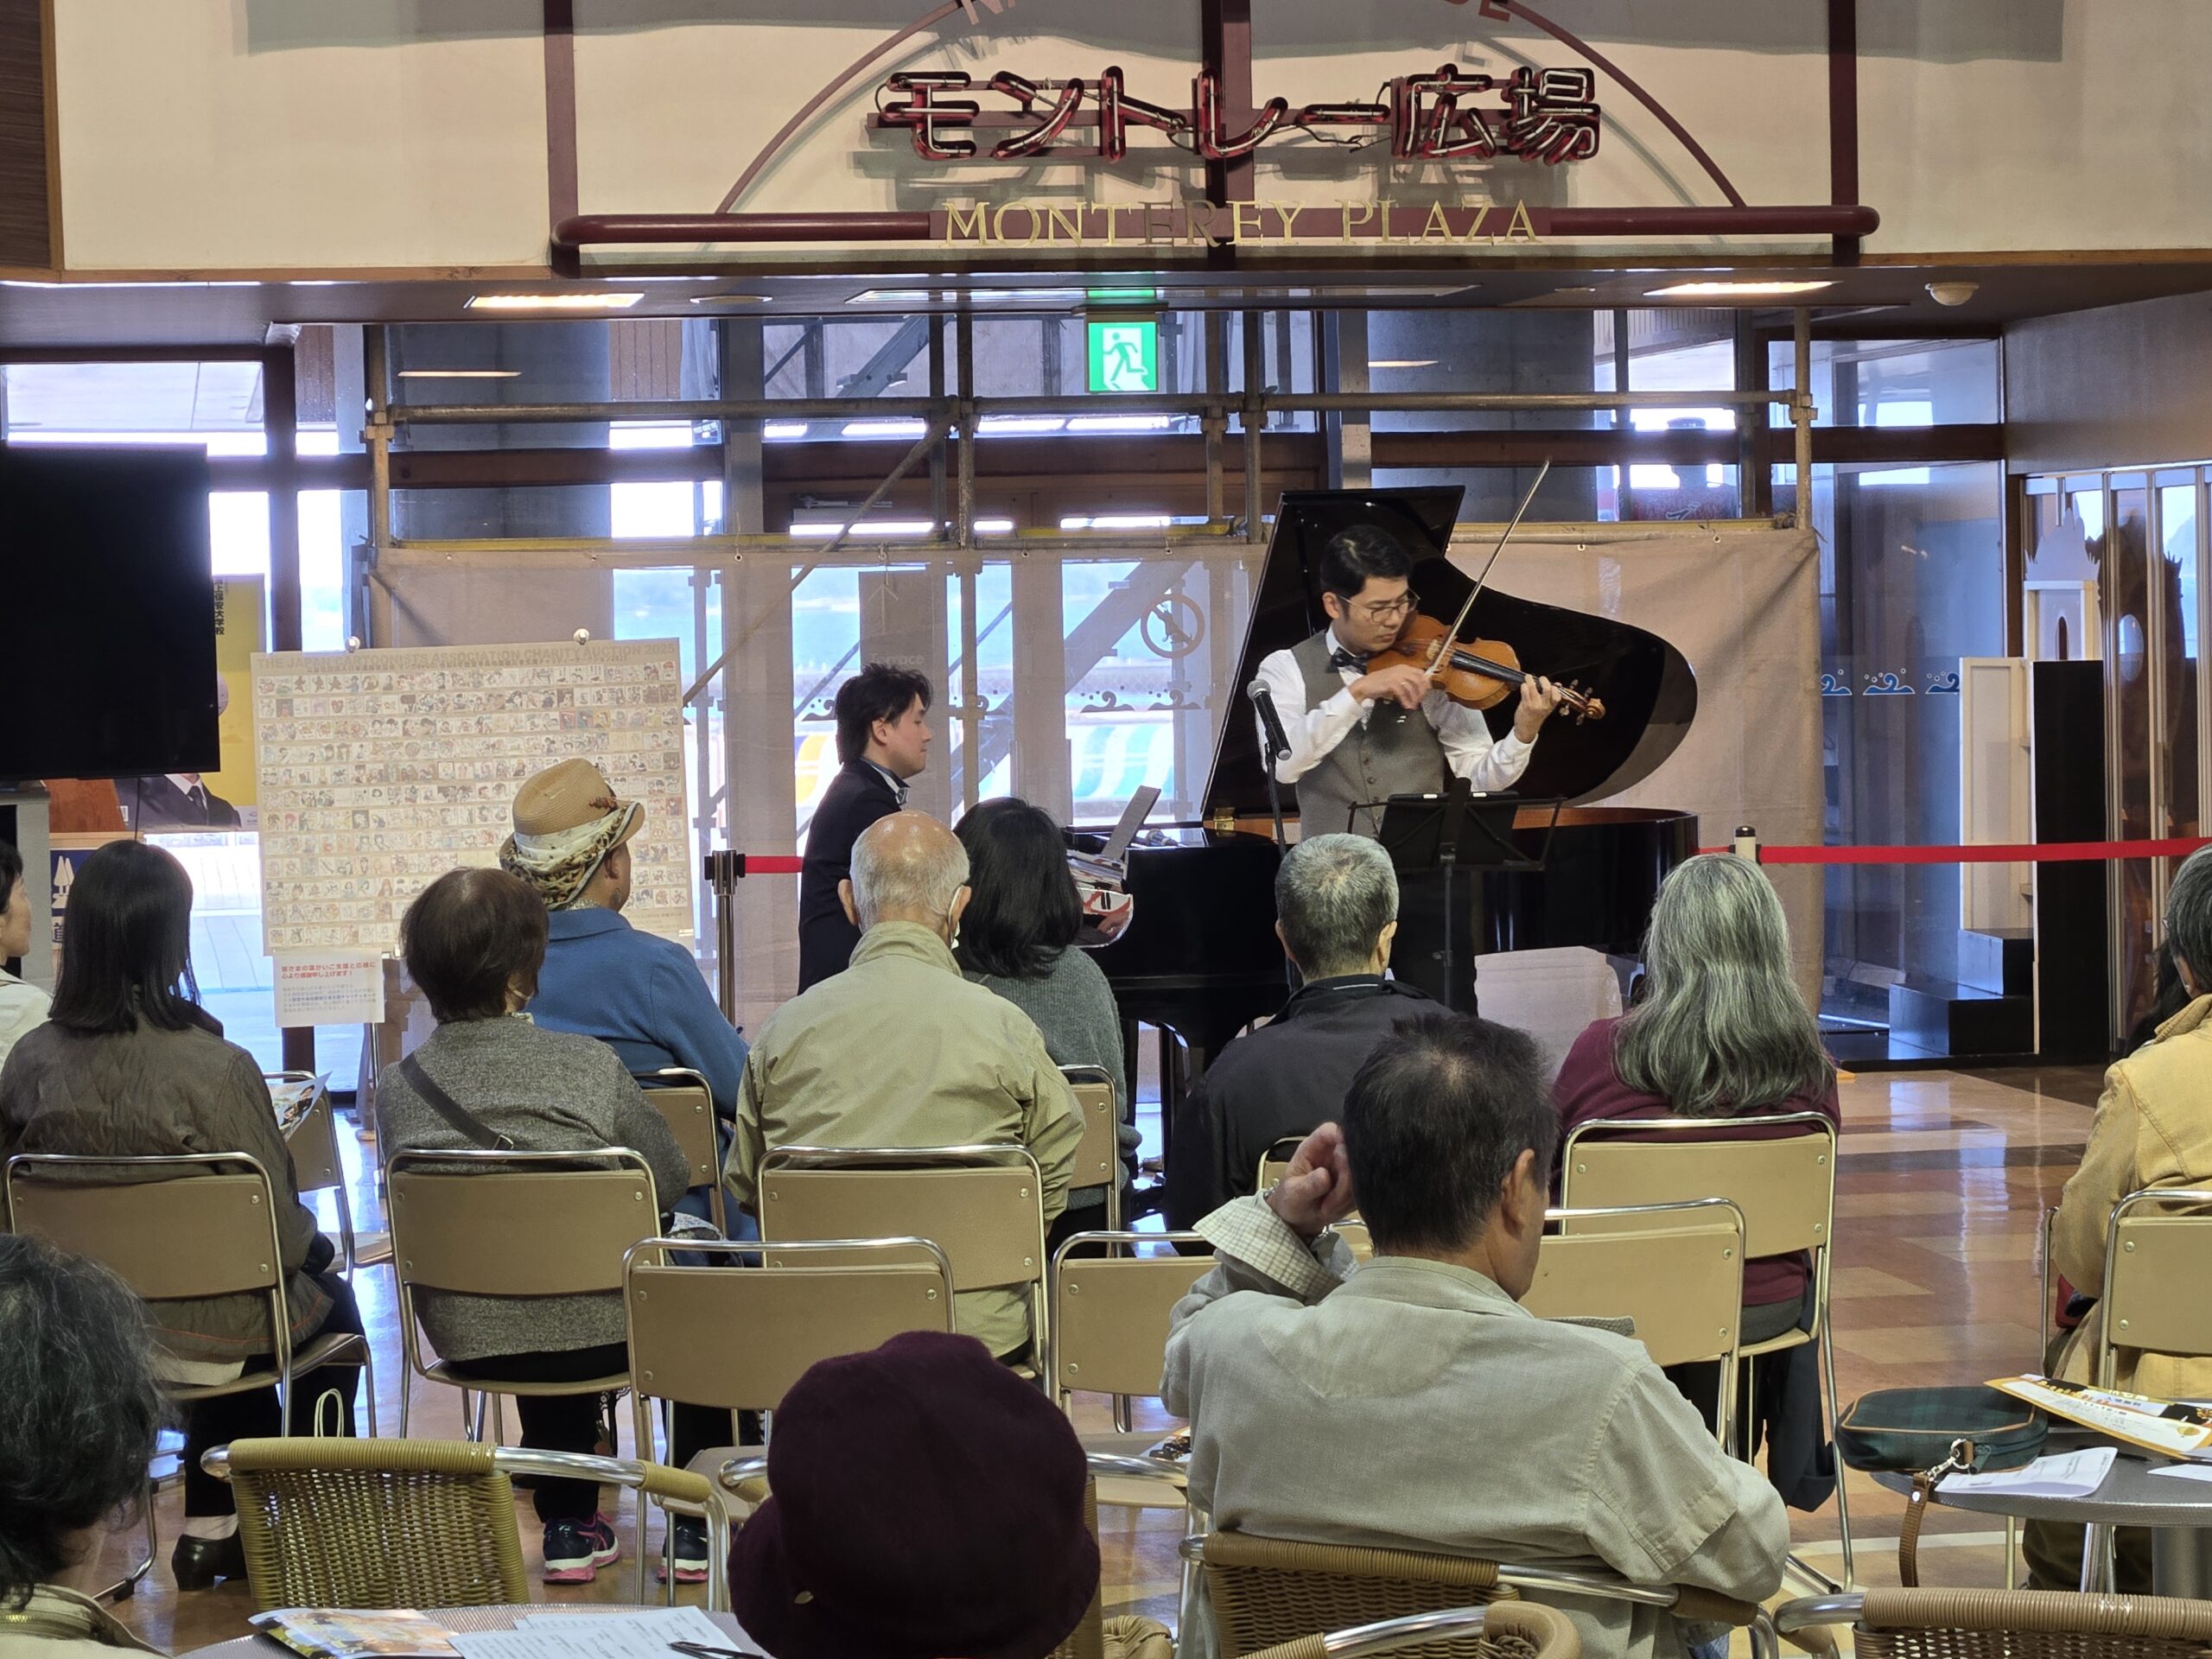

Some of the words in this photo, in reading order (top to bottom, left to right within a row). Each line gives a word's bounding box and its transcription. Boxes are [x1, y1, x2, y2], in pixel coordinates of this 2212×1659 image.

[880, 63, 1601, 162] モントレー広場
[941, 199, 1306, 248] MONTEREY
[1335, 194, 1544, 246] PLAZA
[257, 658, 284, 669] THE
[287, 656, 331, 668] JAPAN
[335, 653, 428, 666] CARTOONISTS
[431, 650, 520, 663] ASSOCIATION
[524, 647, 582, 659] CHARITY
[582, 645, 641, 657] AUCTION
[643, 643, 676, 655] 2025
